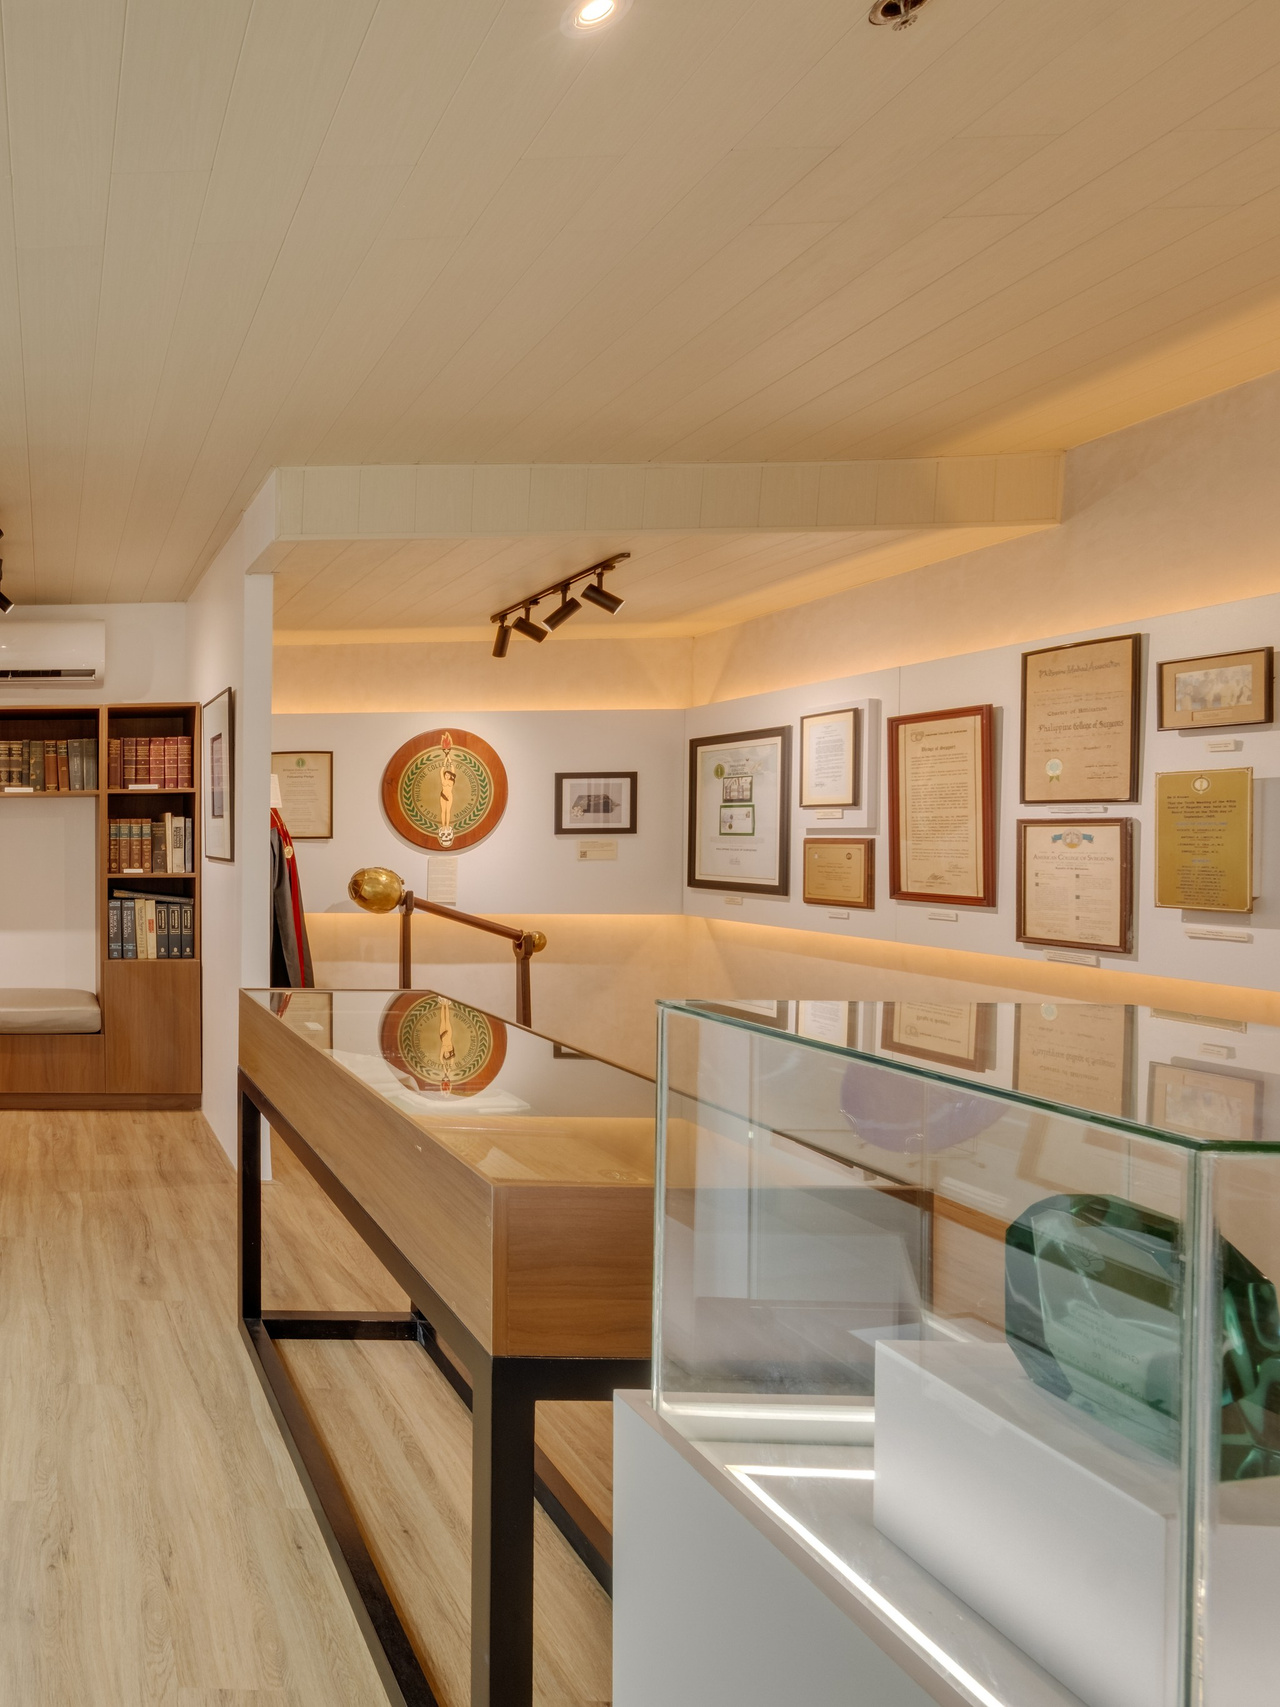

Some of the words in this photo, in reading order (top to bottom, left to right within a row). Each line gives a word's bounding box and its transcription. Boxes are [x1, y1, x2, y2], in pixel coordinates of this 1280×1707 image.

[1038, 722, 1072, 733] Philippine
[1073, 720, 1092, 730] College
[1098, 719, 1124, 730] Surgeons
[415, 771, 428, 802] PHILIPPINE
[427, 760, 454, 773] COLLEGE
[455, 762, 464, 770] OF
[461, 766, 477, 798] SURGEONS
[453, 801, 474, 819] MANILA
